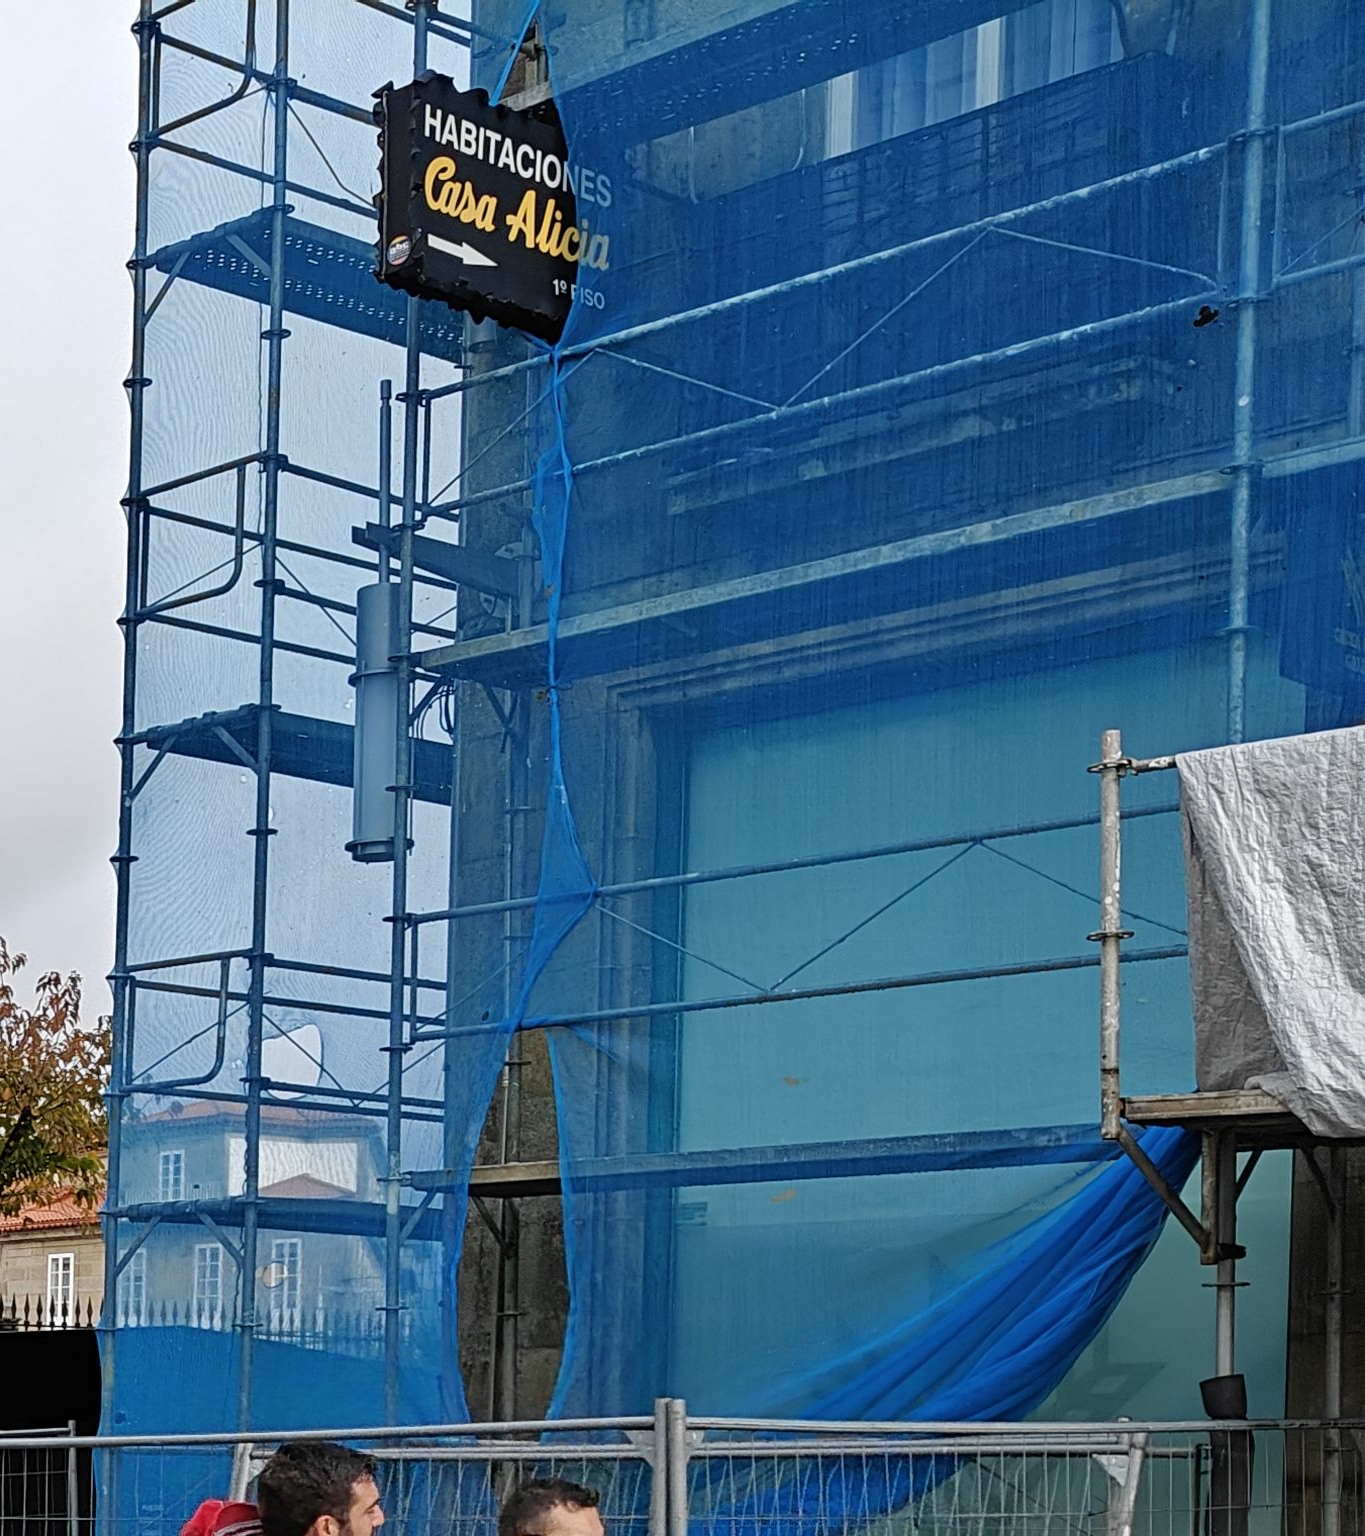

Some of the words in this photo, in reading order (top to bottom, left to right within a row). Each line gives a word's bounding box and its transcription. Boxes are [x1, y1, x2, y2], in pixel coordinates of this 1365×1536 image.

[424, 103, 612, 208] HABITACIONES
[424, 156, 498, 233] Casa
[505, 189, 610, 272] Alicia
